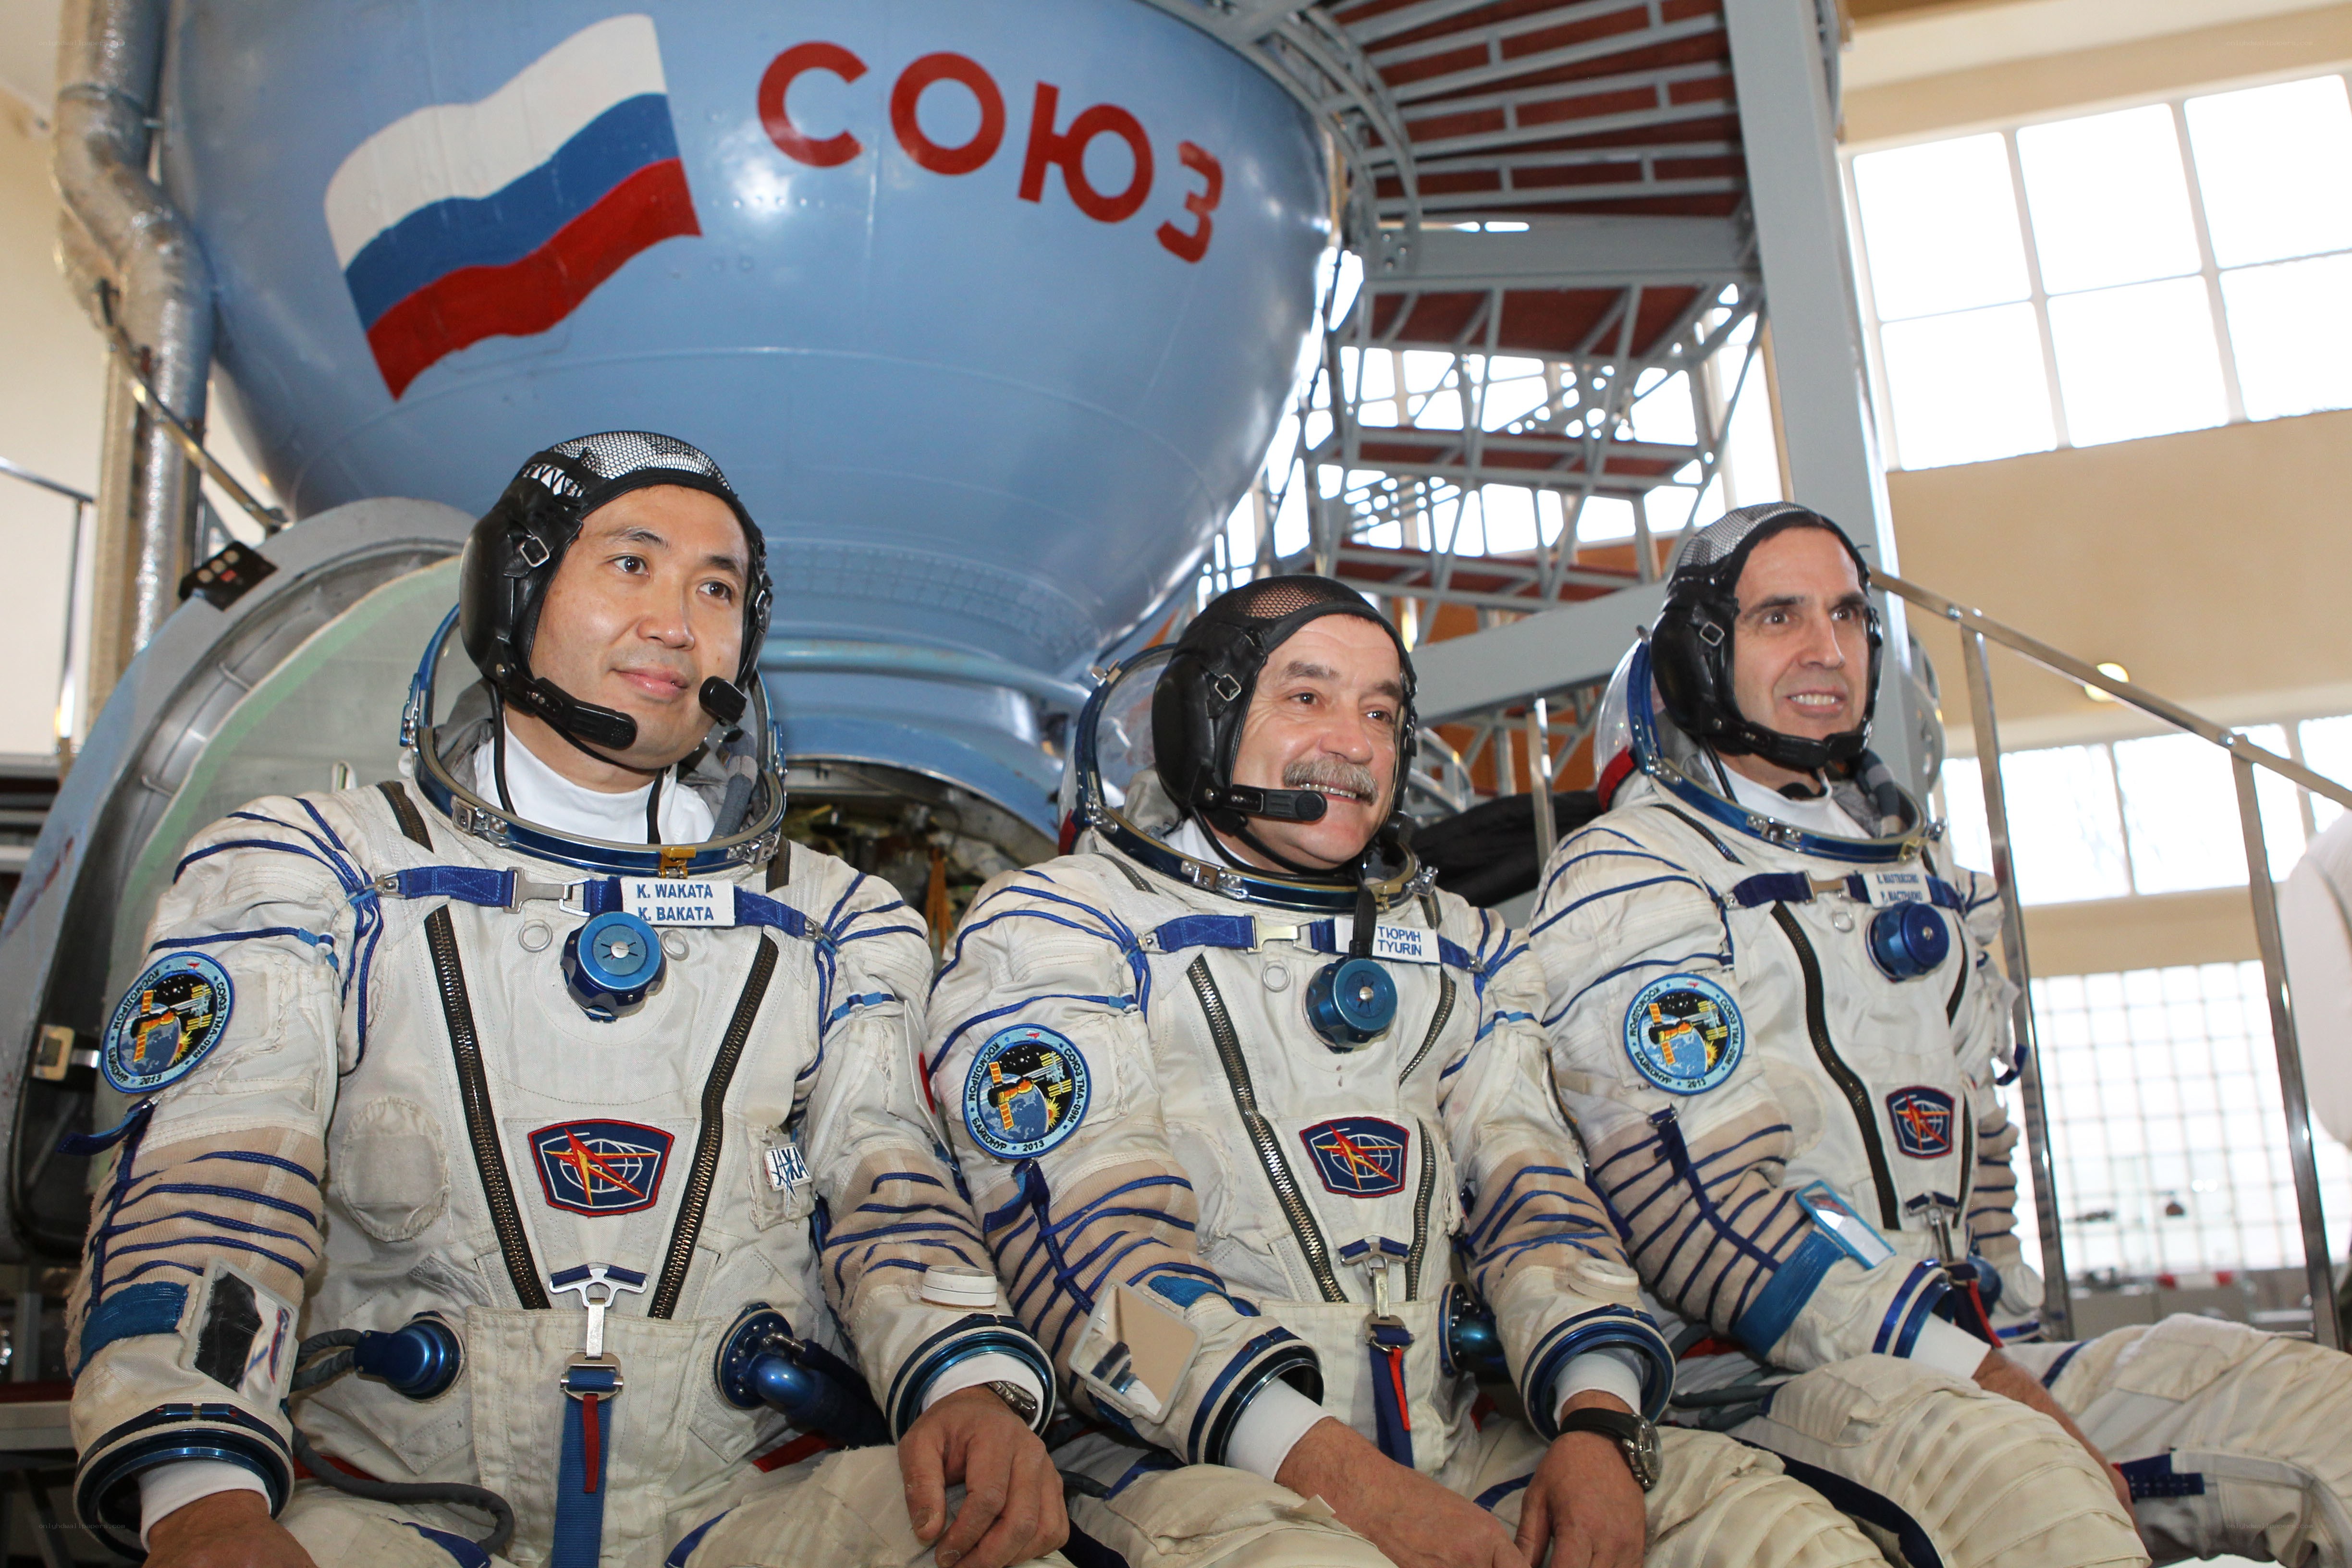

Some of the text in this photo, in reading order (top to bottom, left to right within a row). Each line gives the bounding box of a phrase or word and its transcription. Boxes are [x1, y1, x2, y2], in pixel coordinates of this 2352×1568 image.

[757, 40, 1223, 263] СОЮЗ
[637, 884, 713, 898] K. WAKATA
[656, 906, 714, 921] ВАКАТА
[1377, 926, 1421, 942] ТЮРИН
[1377, 939, 1422, 956] TYURIN
[968, 1042, 1000, 1102] КОСМОДРОМ
[1064, 1048, 1085, 1124] СОЮЗ ТМА-09М
[1023, 1140, 1044, 1152] 2013
[772, 1146, 809, 1198] JAXA
